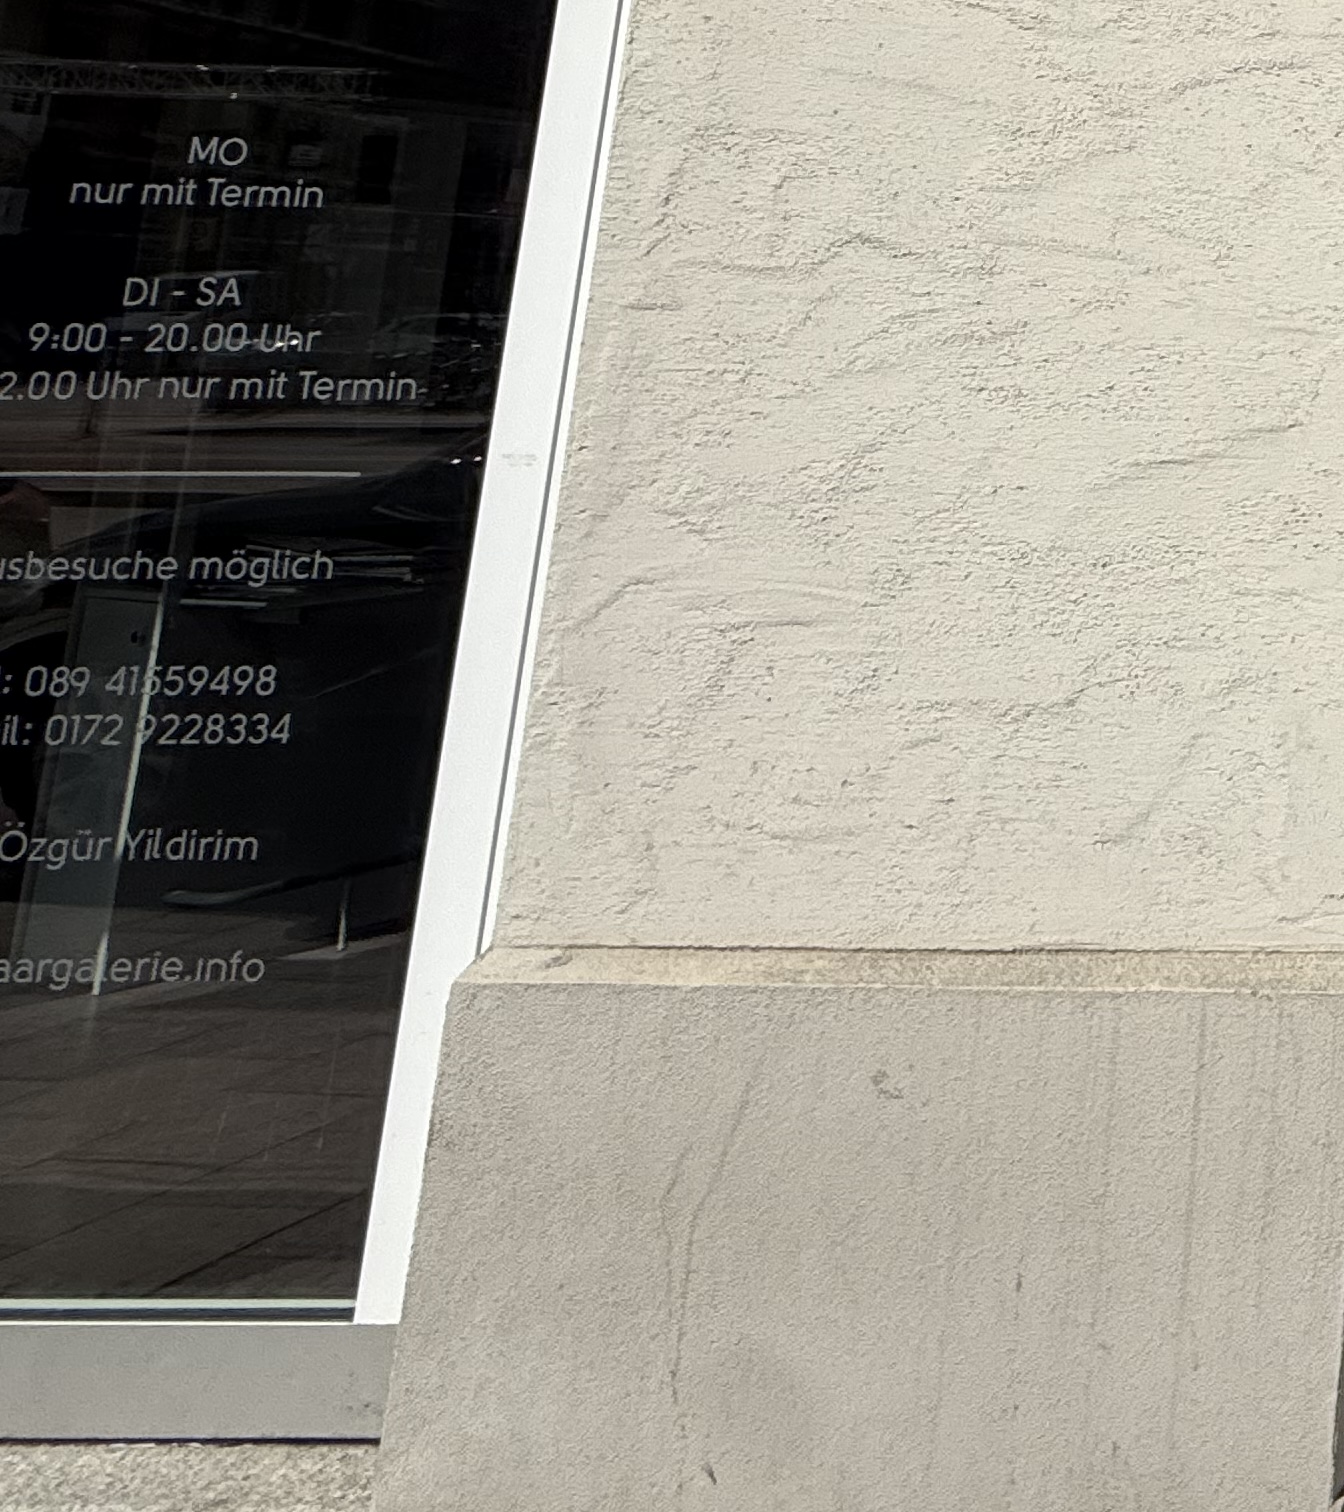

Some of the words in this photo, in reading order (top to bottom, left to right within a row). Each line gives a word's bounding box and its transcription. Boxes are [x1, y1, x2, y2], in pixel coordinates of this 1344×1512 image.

[186, 135, 249, 167] MO
[69, 180, 132, 206] nur
[140, 178, 198, 207] mit
[206, 176, 325, 209] Termin
[121, 276, 161, 308] DI
[195, 276, 242, 308] SA
[28, 322, 107, 353] 9:00
[144, 322, 246, 353] 20.00
[258, 324, 322, 353] Uhr
[87, 370, 150, 401] Uhr
[157, 377, 220, 401] nur
[229, 372, 288, 401] mit
[299, 370, 418, 402] Termin
[188, 548, 334, 588] möglich
[24, 665, 91, 697] 089
[45, 713, 123, 746] 0172
[135, 713, 292, 746] 9228334
[0, 820, 113, 870] Özgür
[123, 827, 259, 861] Yildirim
